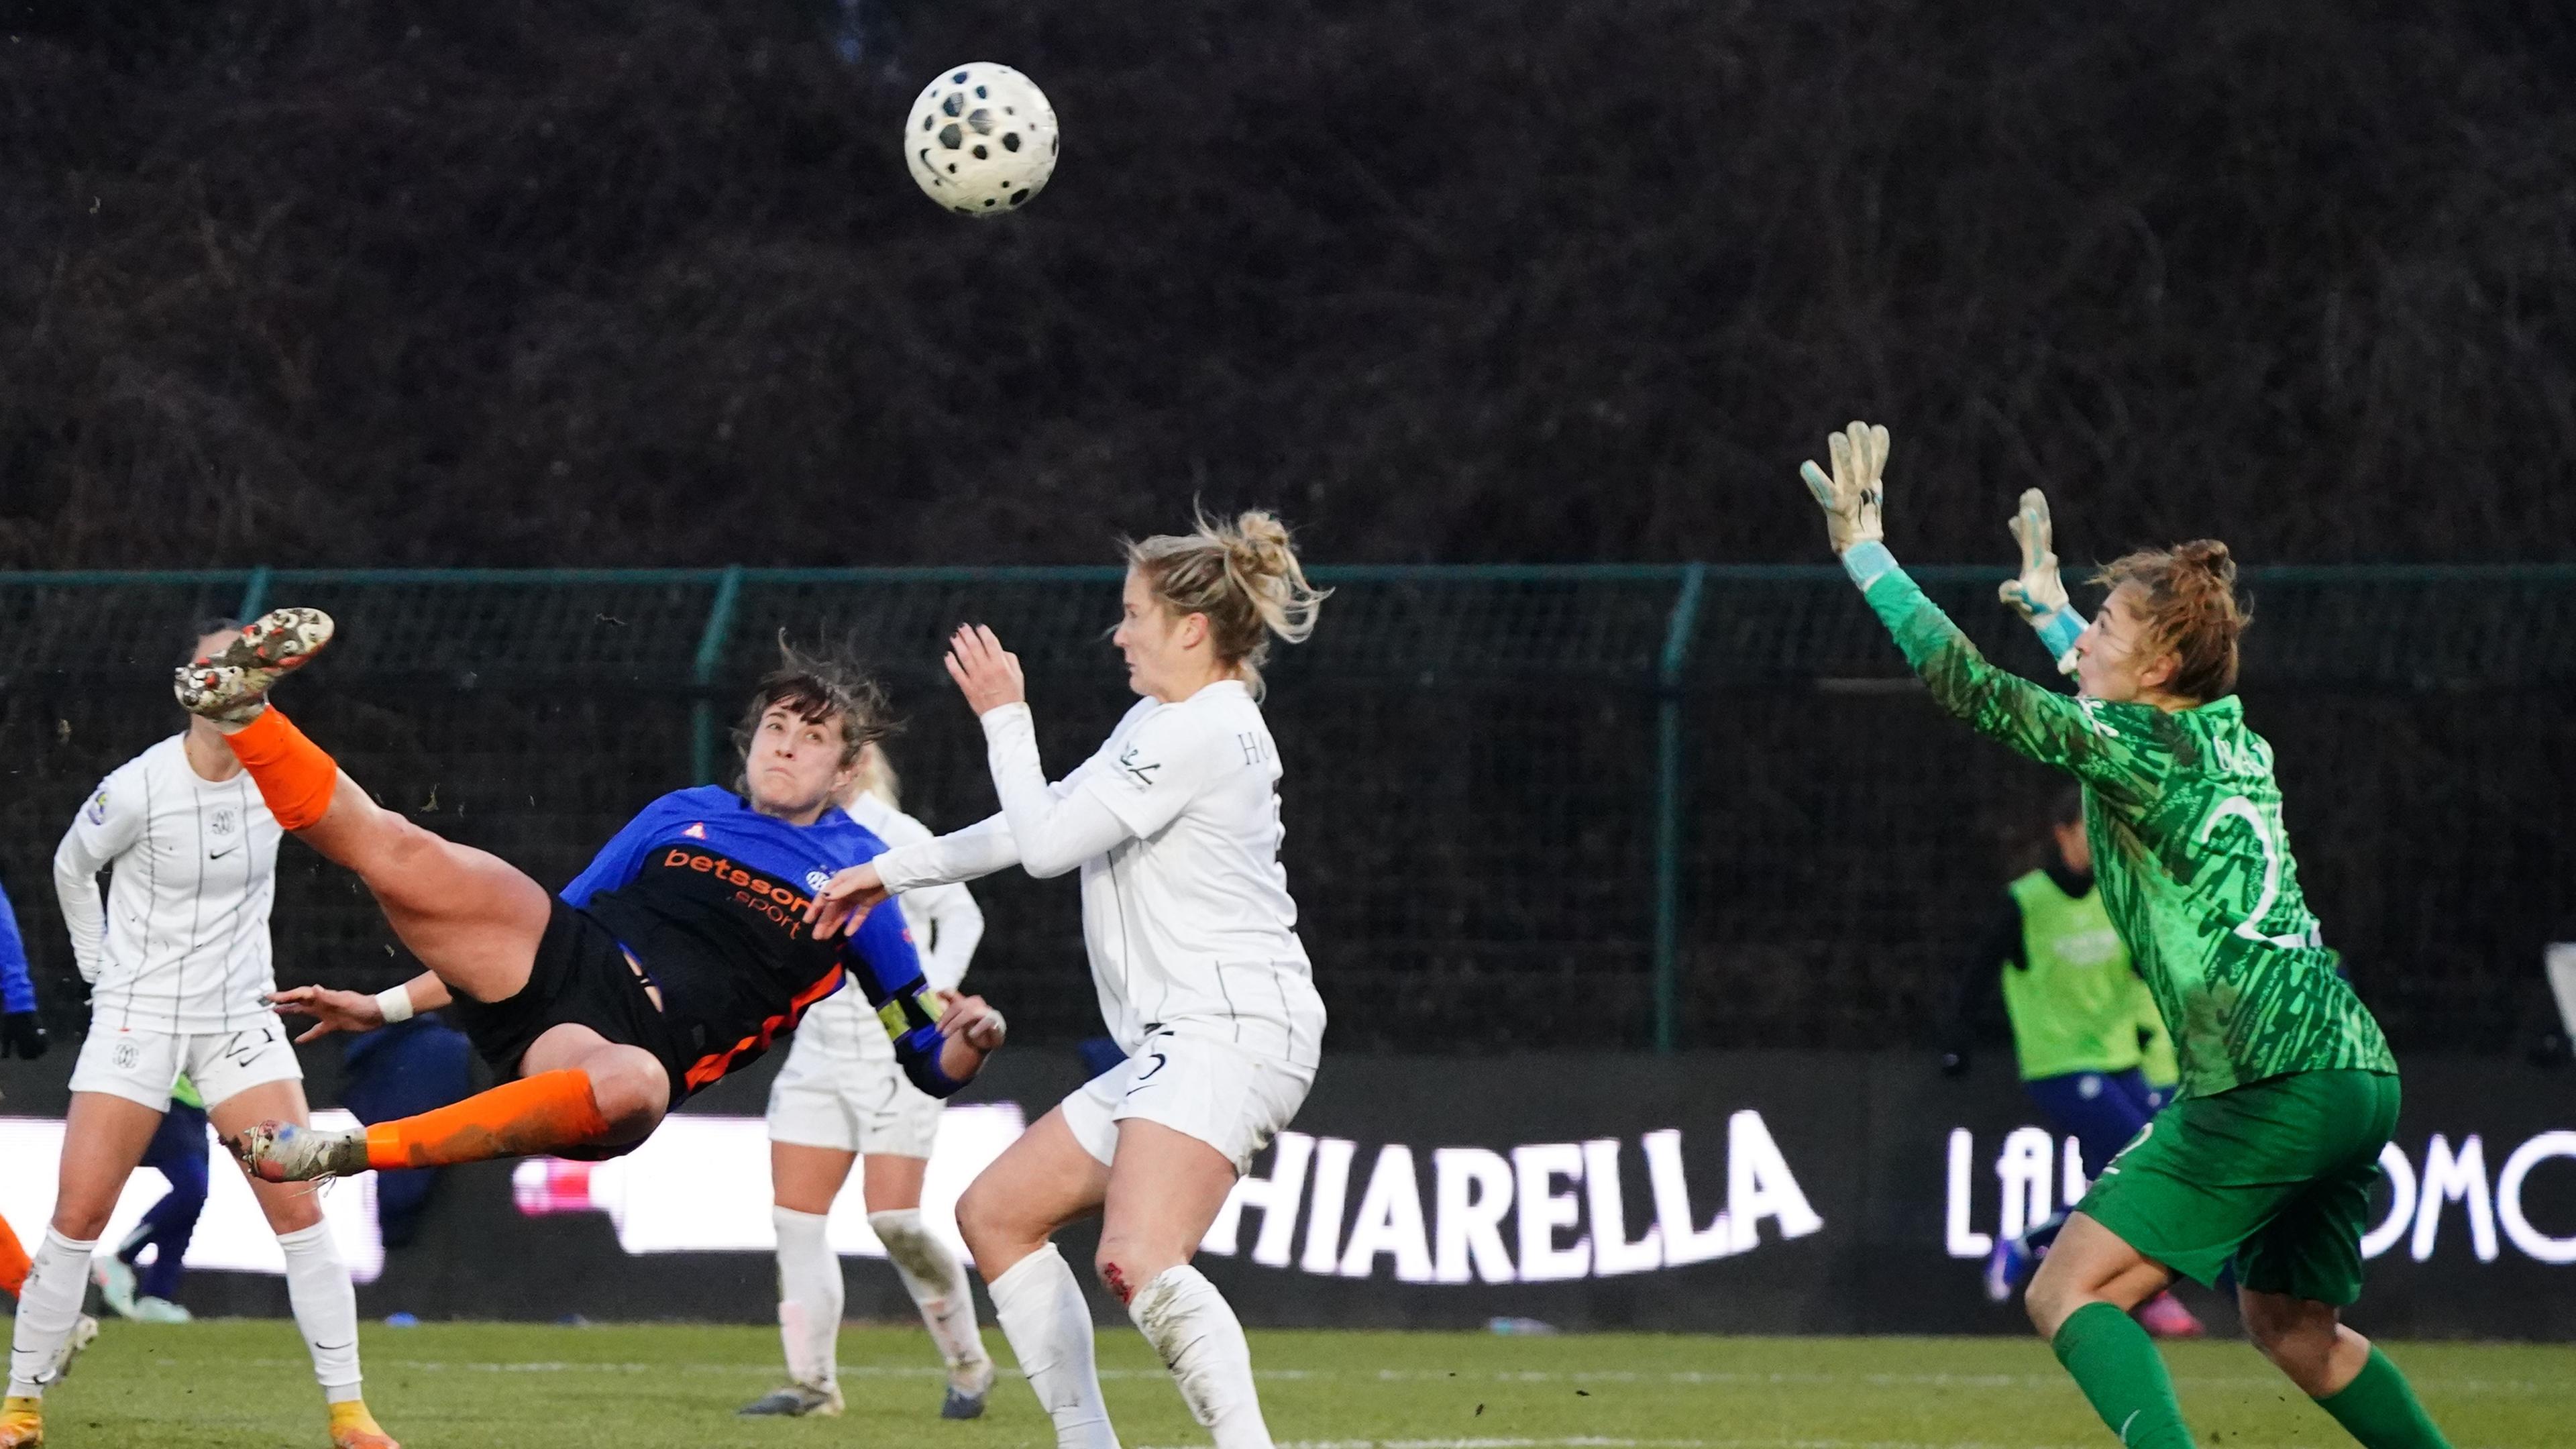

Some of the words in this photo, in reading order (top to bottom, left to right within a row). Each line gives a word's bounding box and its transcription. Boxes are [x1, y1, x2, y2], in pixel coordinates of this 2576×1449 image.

[663, 849, 814, 914] betsson
[2201, 795, 2322, 949] 2
[1199, 1110, 1825, 1284] HIARELLA
